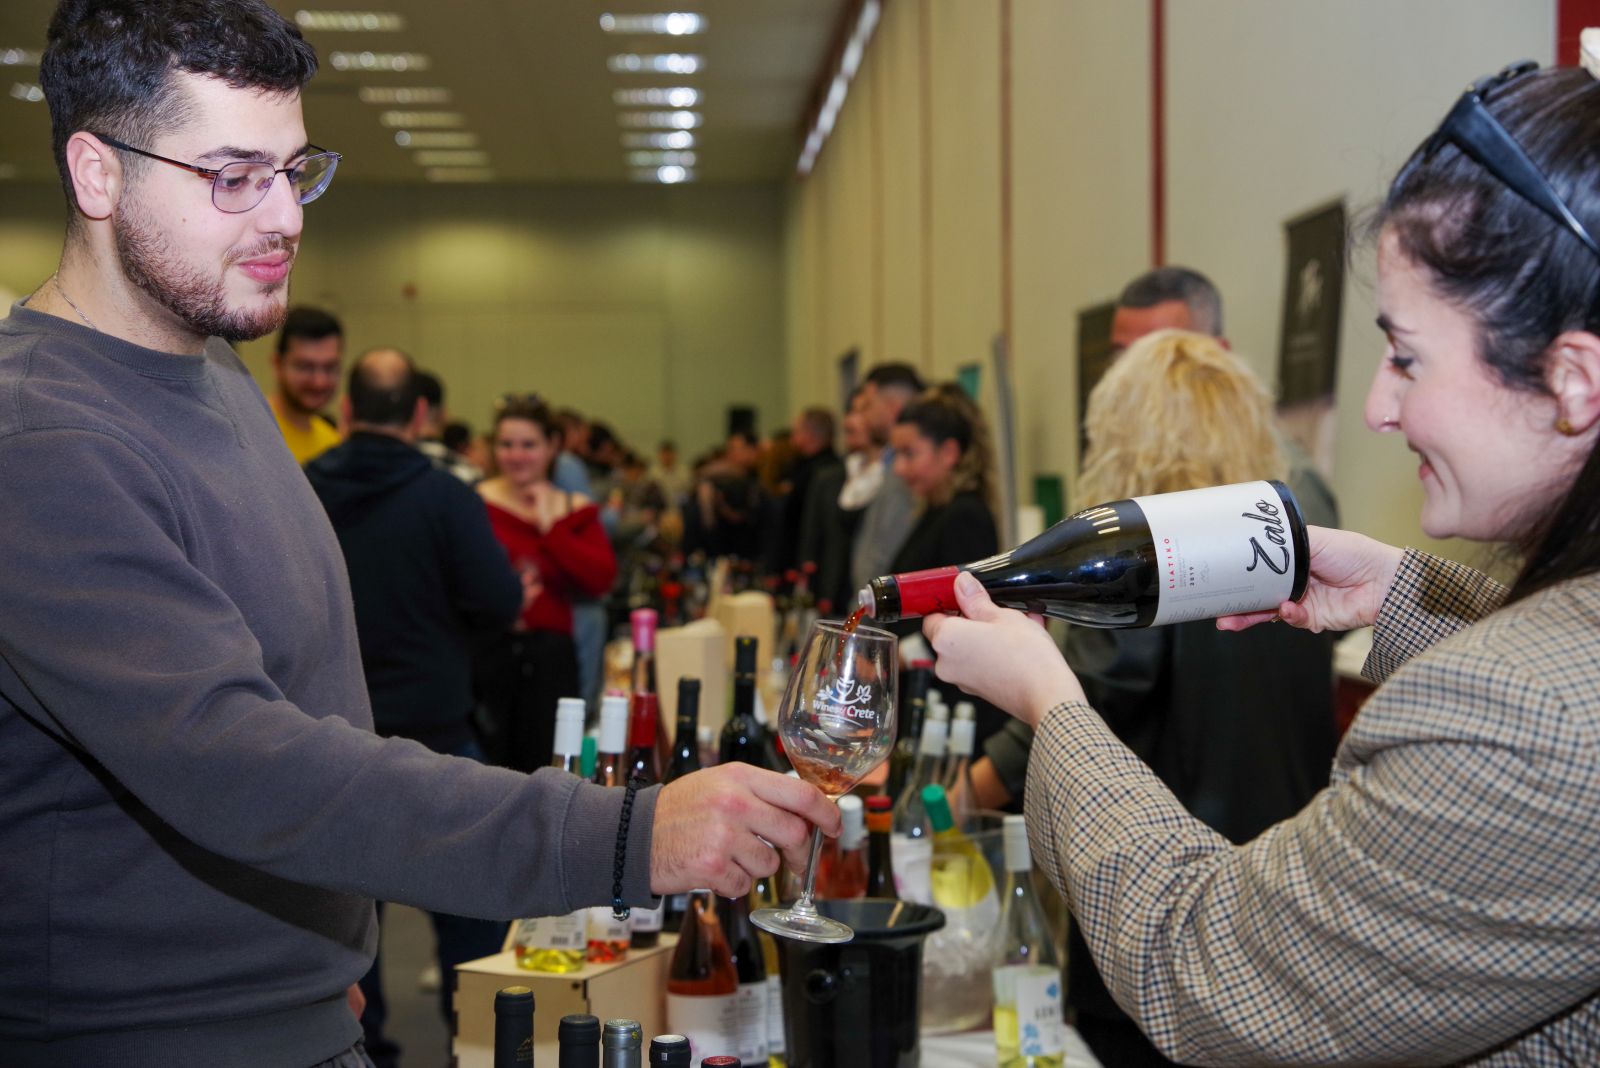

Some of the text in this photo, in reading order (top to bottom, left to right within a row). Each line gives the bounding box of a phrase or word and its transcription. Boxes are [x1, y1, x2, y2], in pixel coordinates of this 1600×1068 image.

[1241, 499, 1290, 575] Zalo
[1163, 538, 1176, 589] LIATIKO
[813, 700, 838, 714] Wines
[846, 705, 876, 720] Crete
